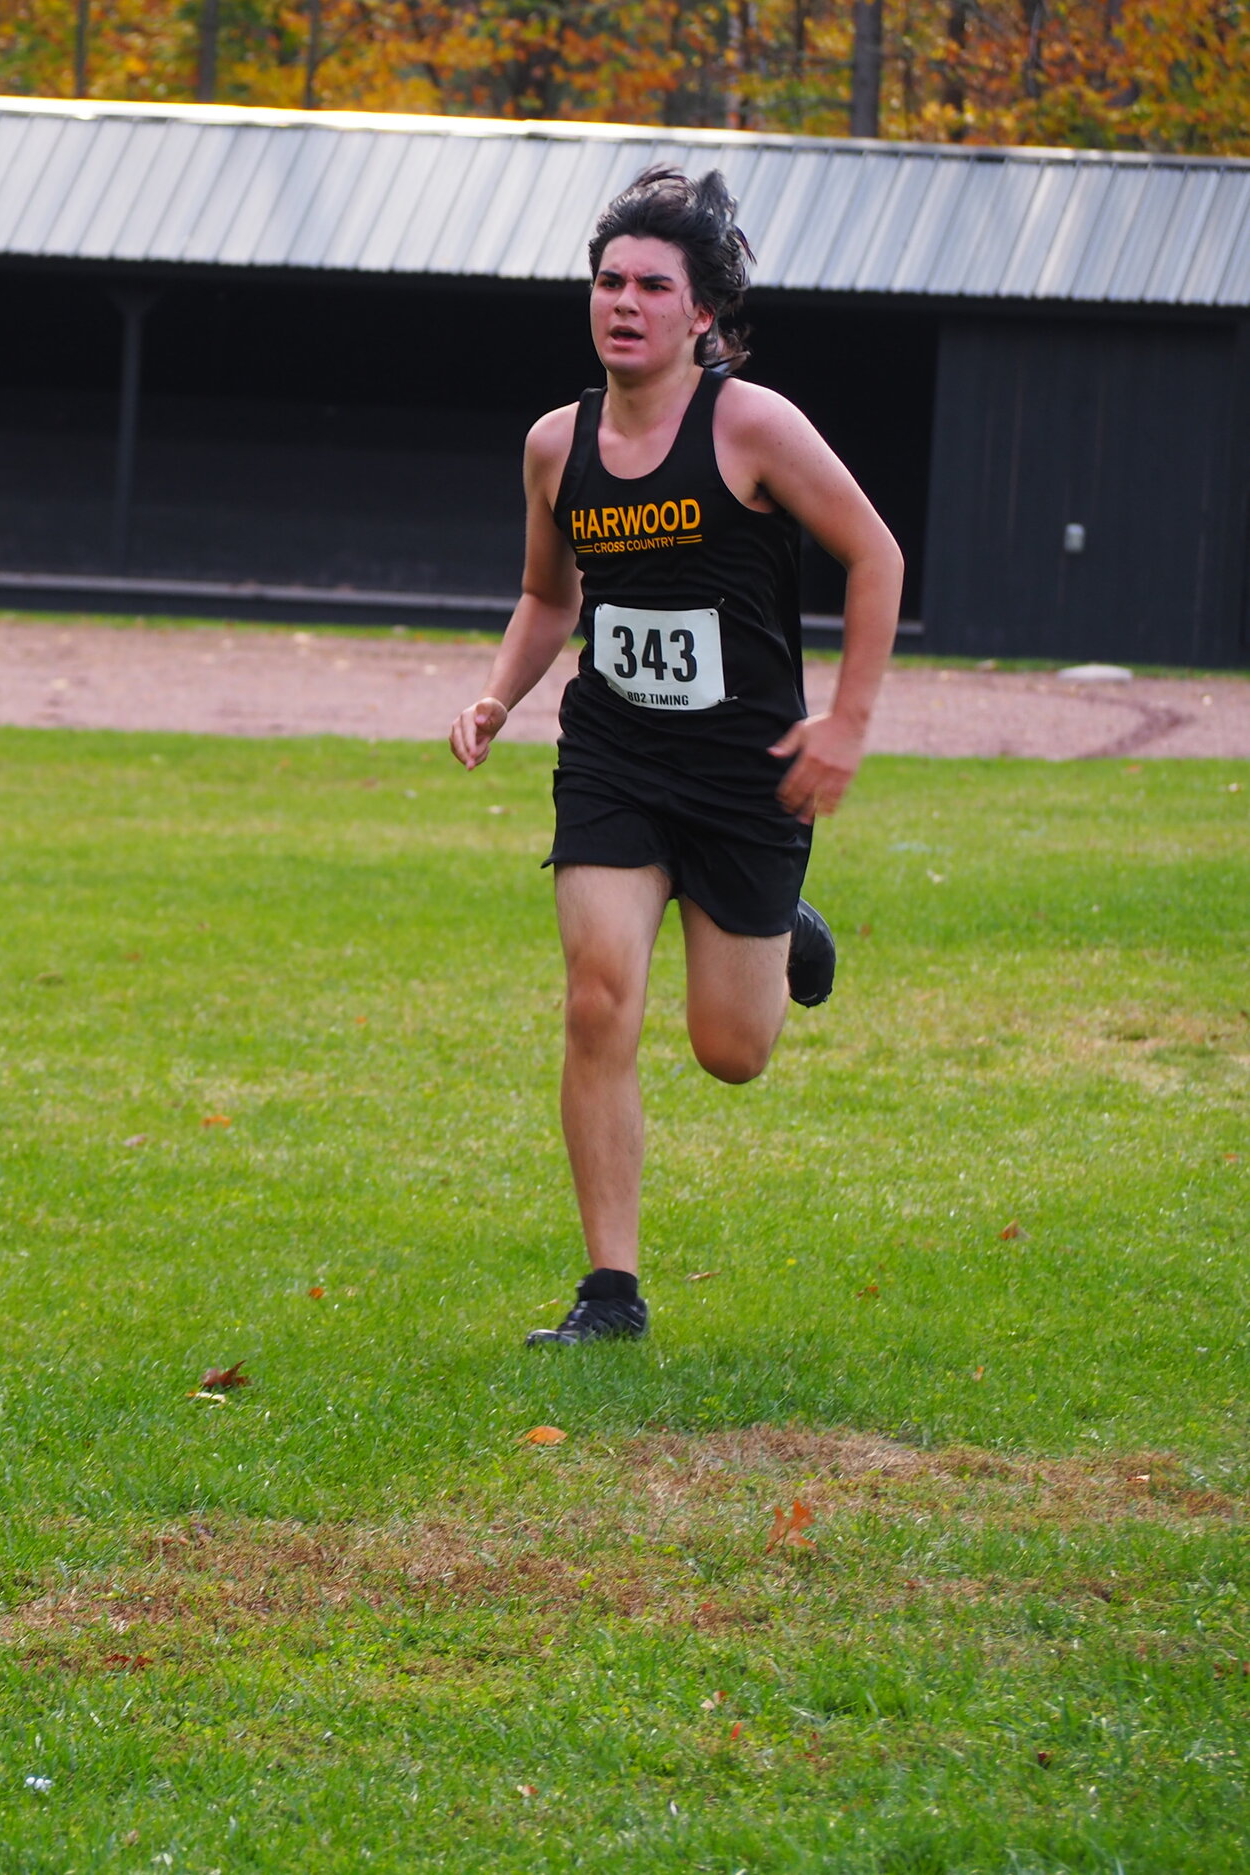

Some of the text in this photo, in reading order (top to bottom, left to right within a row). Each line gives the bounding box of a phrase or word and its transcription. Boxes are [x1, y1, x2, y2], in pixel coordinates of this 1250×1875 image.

[571, 498, 701, 540] HARWOOD
[594, 536, 675, 553] CROSS COUNTRY
[612, 625, 698, 683] 343
[627, 691, 690, 707] 802 TIMING
